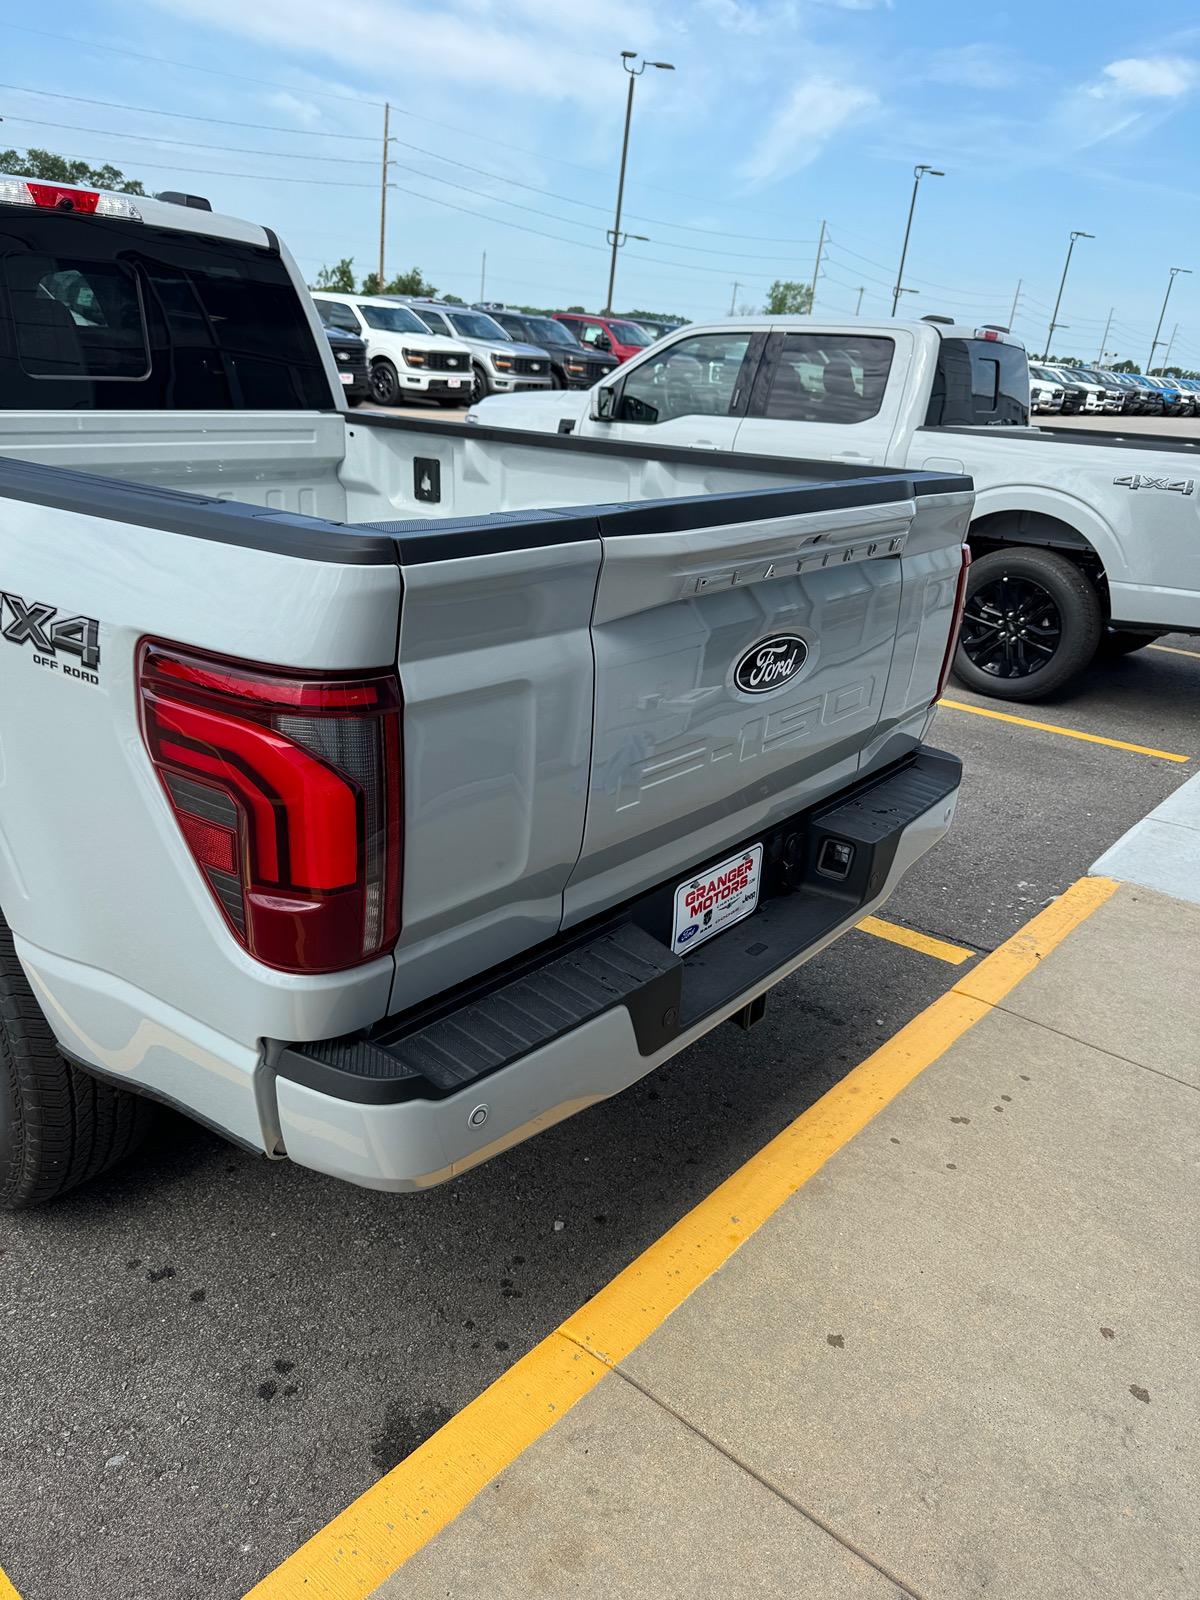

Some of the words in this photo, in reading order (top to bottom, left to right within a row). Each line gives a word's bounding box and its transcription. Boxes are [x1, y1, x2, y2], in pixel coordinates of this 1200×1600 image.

[695, 538, 904, 593] PLATINUM
[0, 591, 101, 672] X4
[33, 653, 58, 669] OFF
[63, 665, 99, 685] ROAD
[750, 644, 798, 686] Ford
[615, 675, 876, 812] F-150
[685, 858, 754, 907] GRANGER
[690, 874, 748, 918] MOTORS
